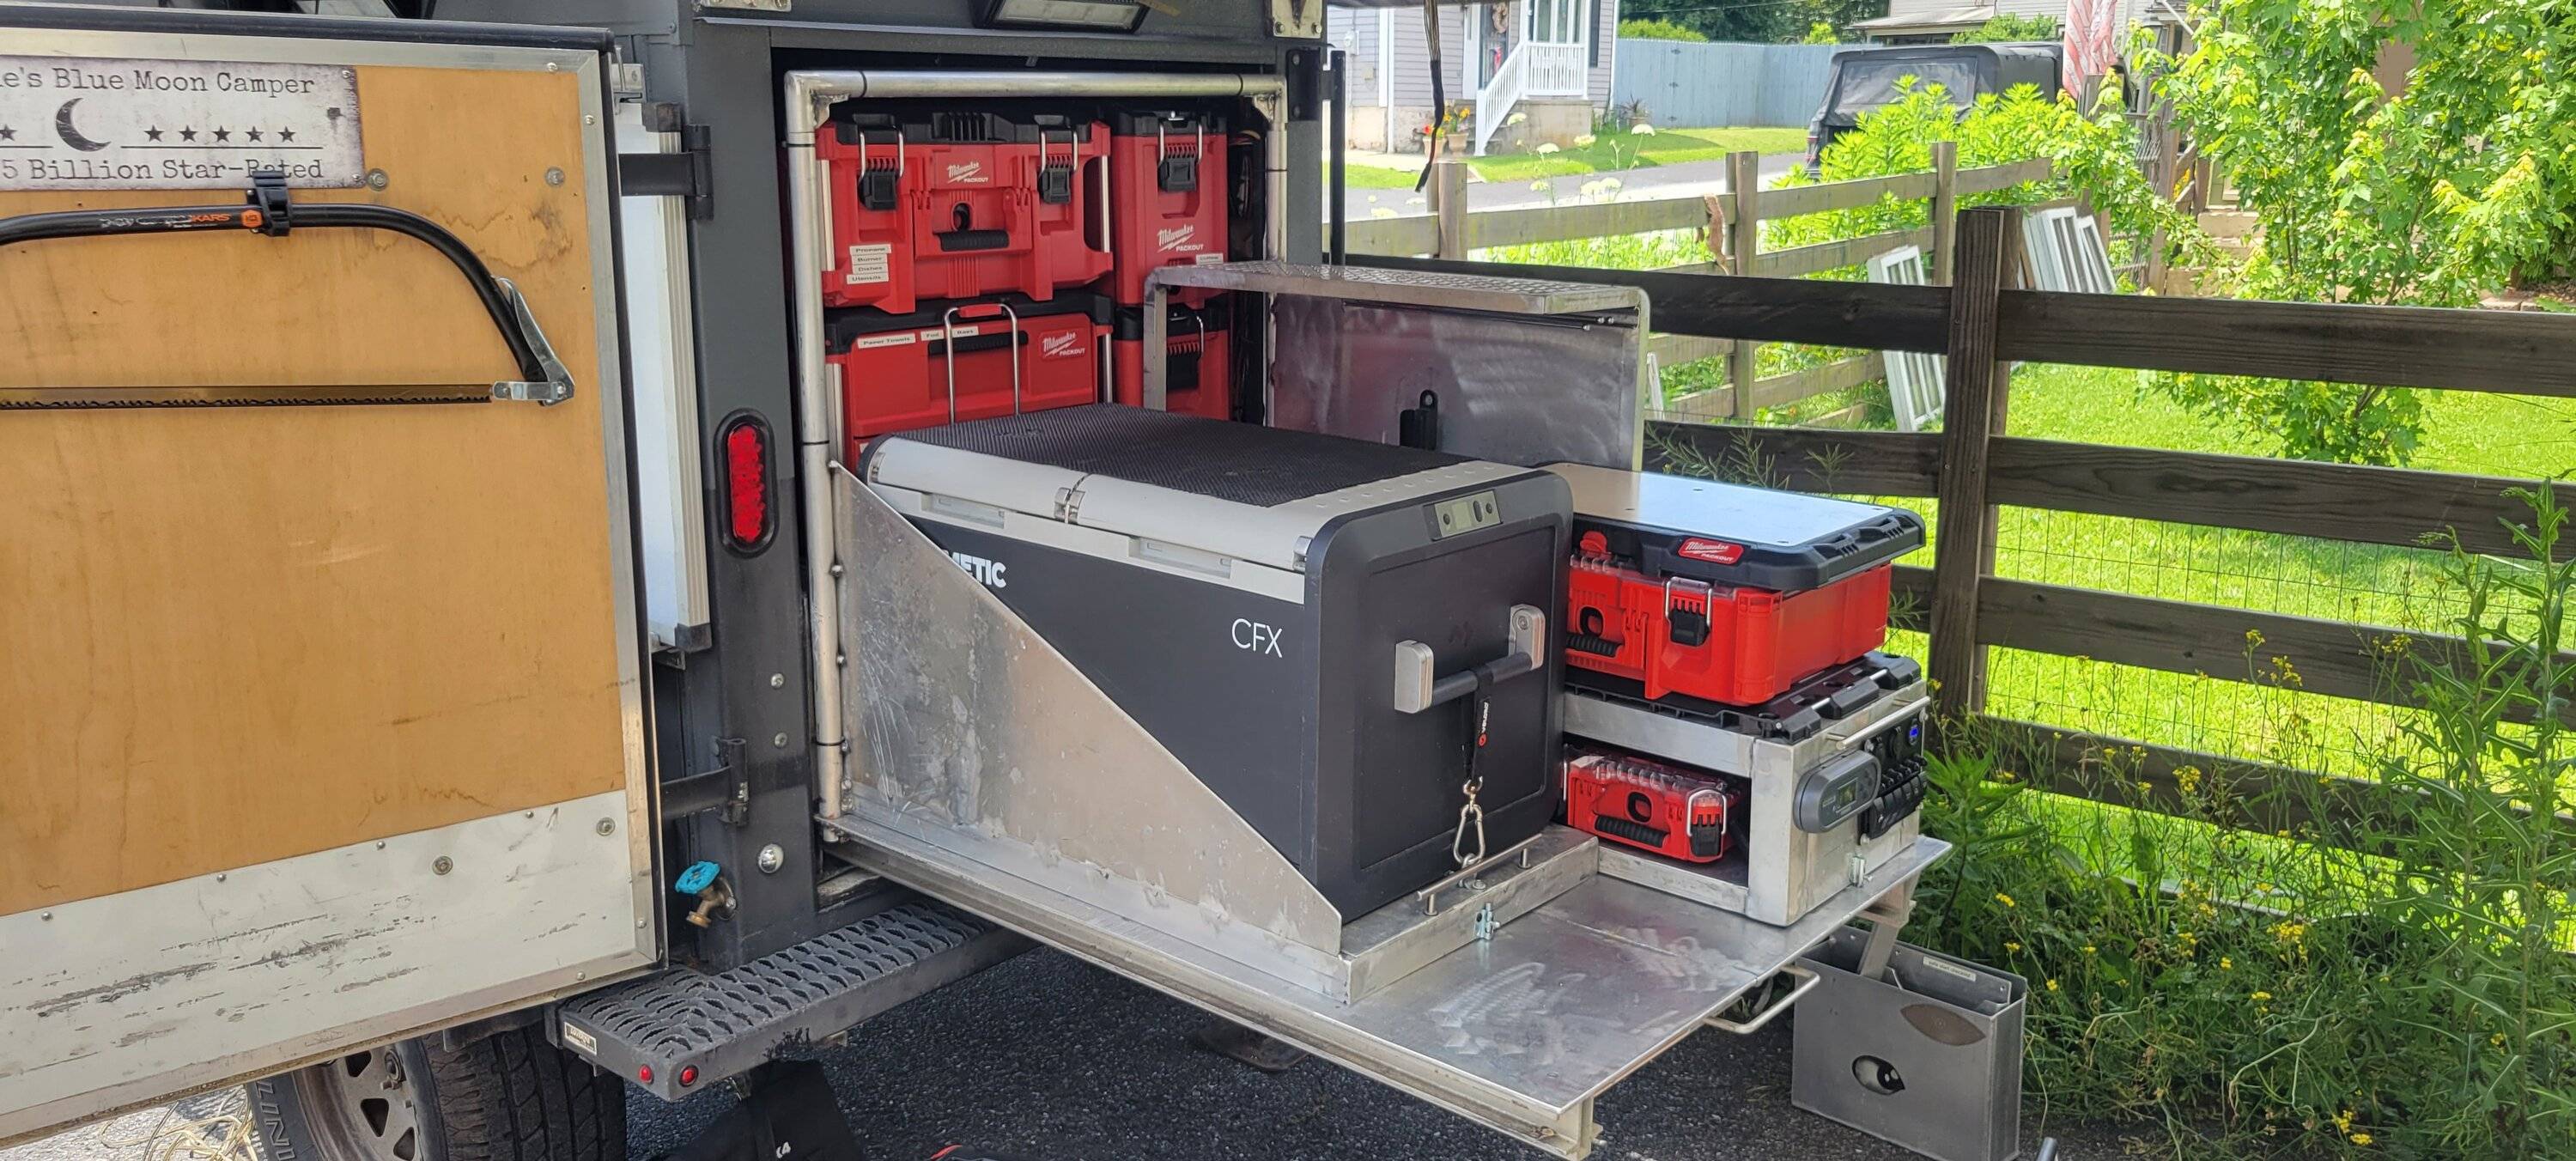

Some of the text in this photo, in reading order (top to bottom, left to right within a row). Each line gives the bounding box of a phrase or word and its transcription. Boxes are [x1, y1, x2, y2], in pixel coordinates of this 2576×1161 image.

[0, 66, 315, 98] e's Blue Moon Camper
[3, 159, 19, 179] 5
[27, 159, 154, 179] Billion
[951, 552, 1007, 588] ETIC
[1231, 618, 1283, 658] CFX
